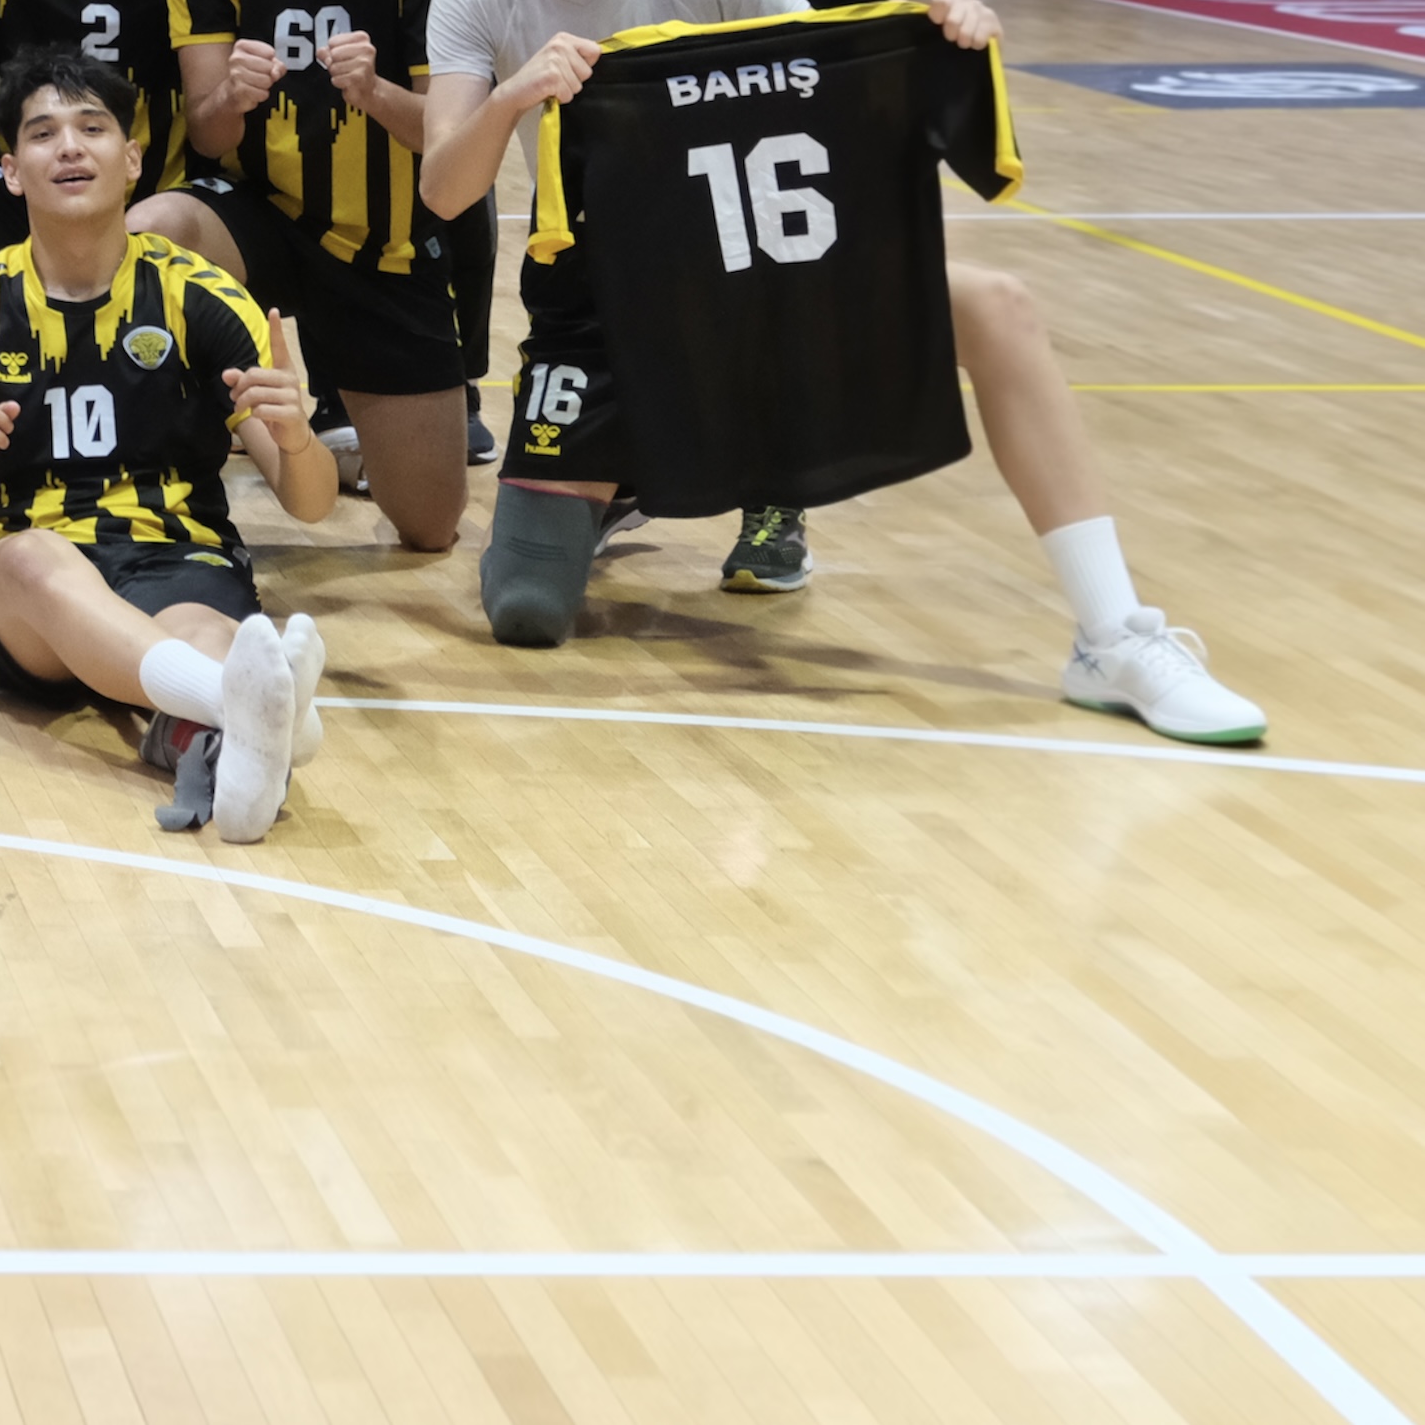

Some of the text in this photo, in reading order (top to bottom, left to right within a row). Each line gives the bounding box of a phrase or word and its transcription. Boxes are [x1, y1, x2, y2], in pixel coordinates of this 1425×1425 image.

[80, 3, 121, 62] 2
[665, 57, 822, 108] BARIŞ
[687, 132, 838, 273] 16
[44, 385, 118, 458] 10
[524, 363, 589, 426] 16
[524, 441, 562, 457] hummel
